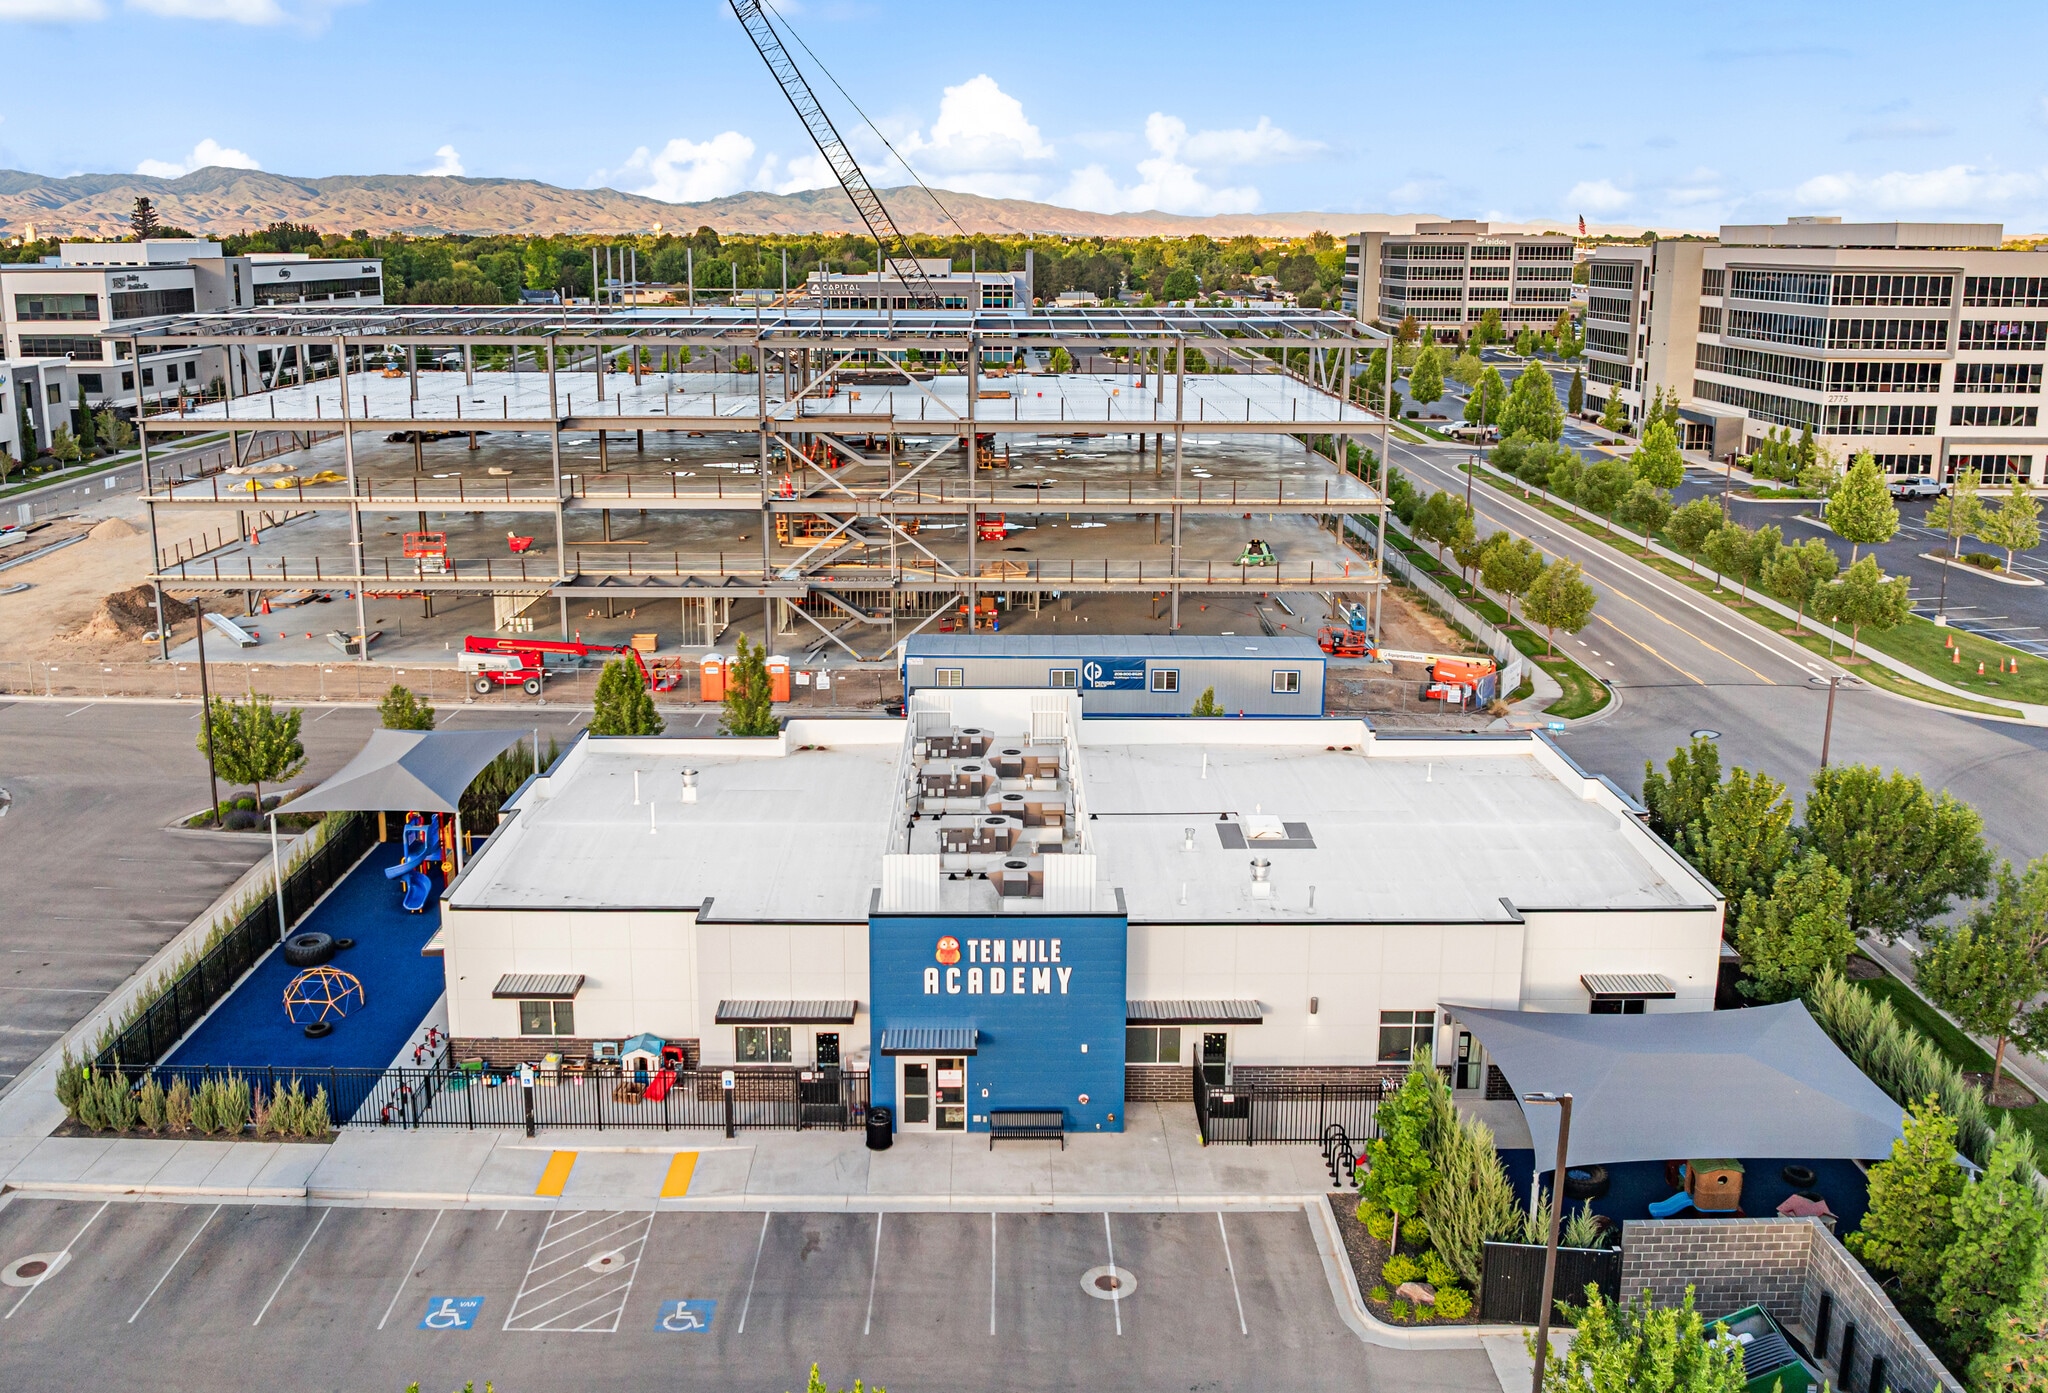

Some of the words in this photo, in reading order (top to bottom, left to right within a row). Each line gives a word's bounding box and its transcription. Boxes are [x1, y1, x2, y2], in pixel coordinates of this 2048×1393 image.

[1828, 395, 1849, 403] 2775
[967, 939, 1005, 962] TEN
[1012, 939, 1061, 962] MILE
[924, 967, 1072, 994] ACADEMY
